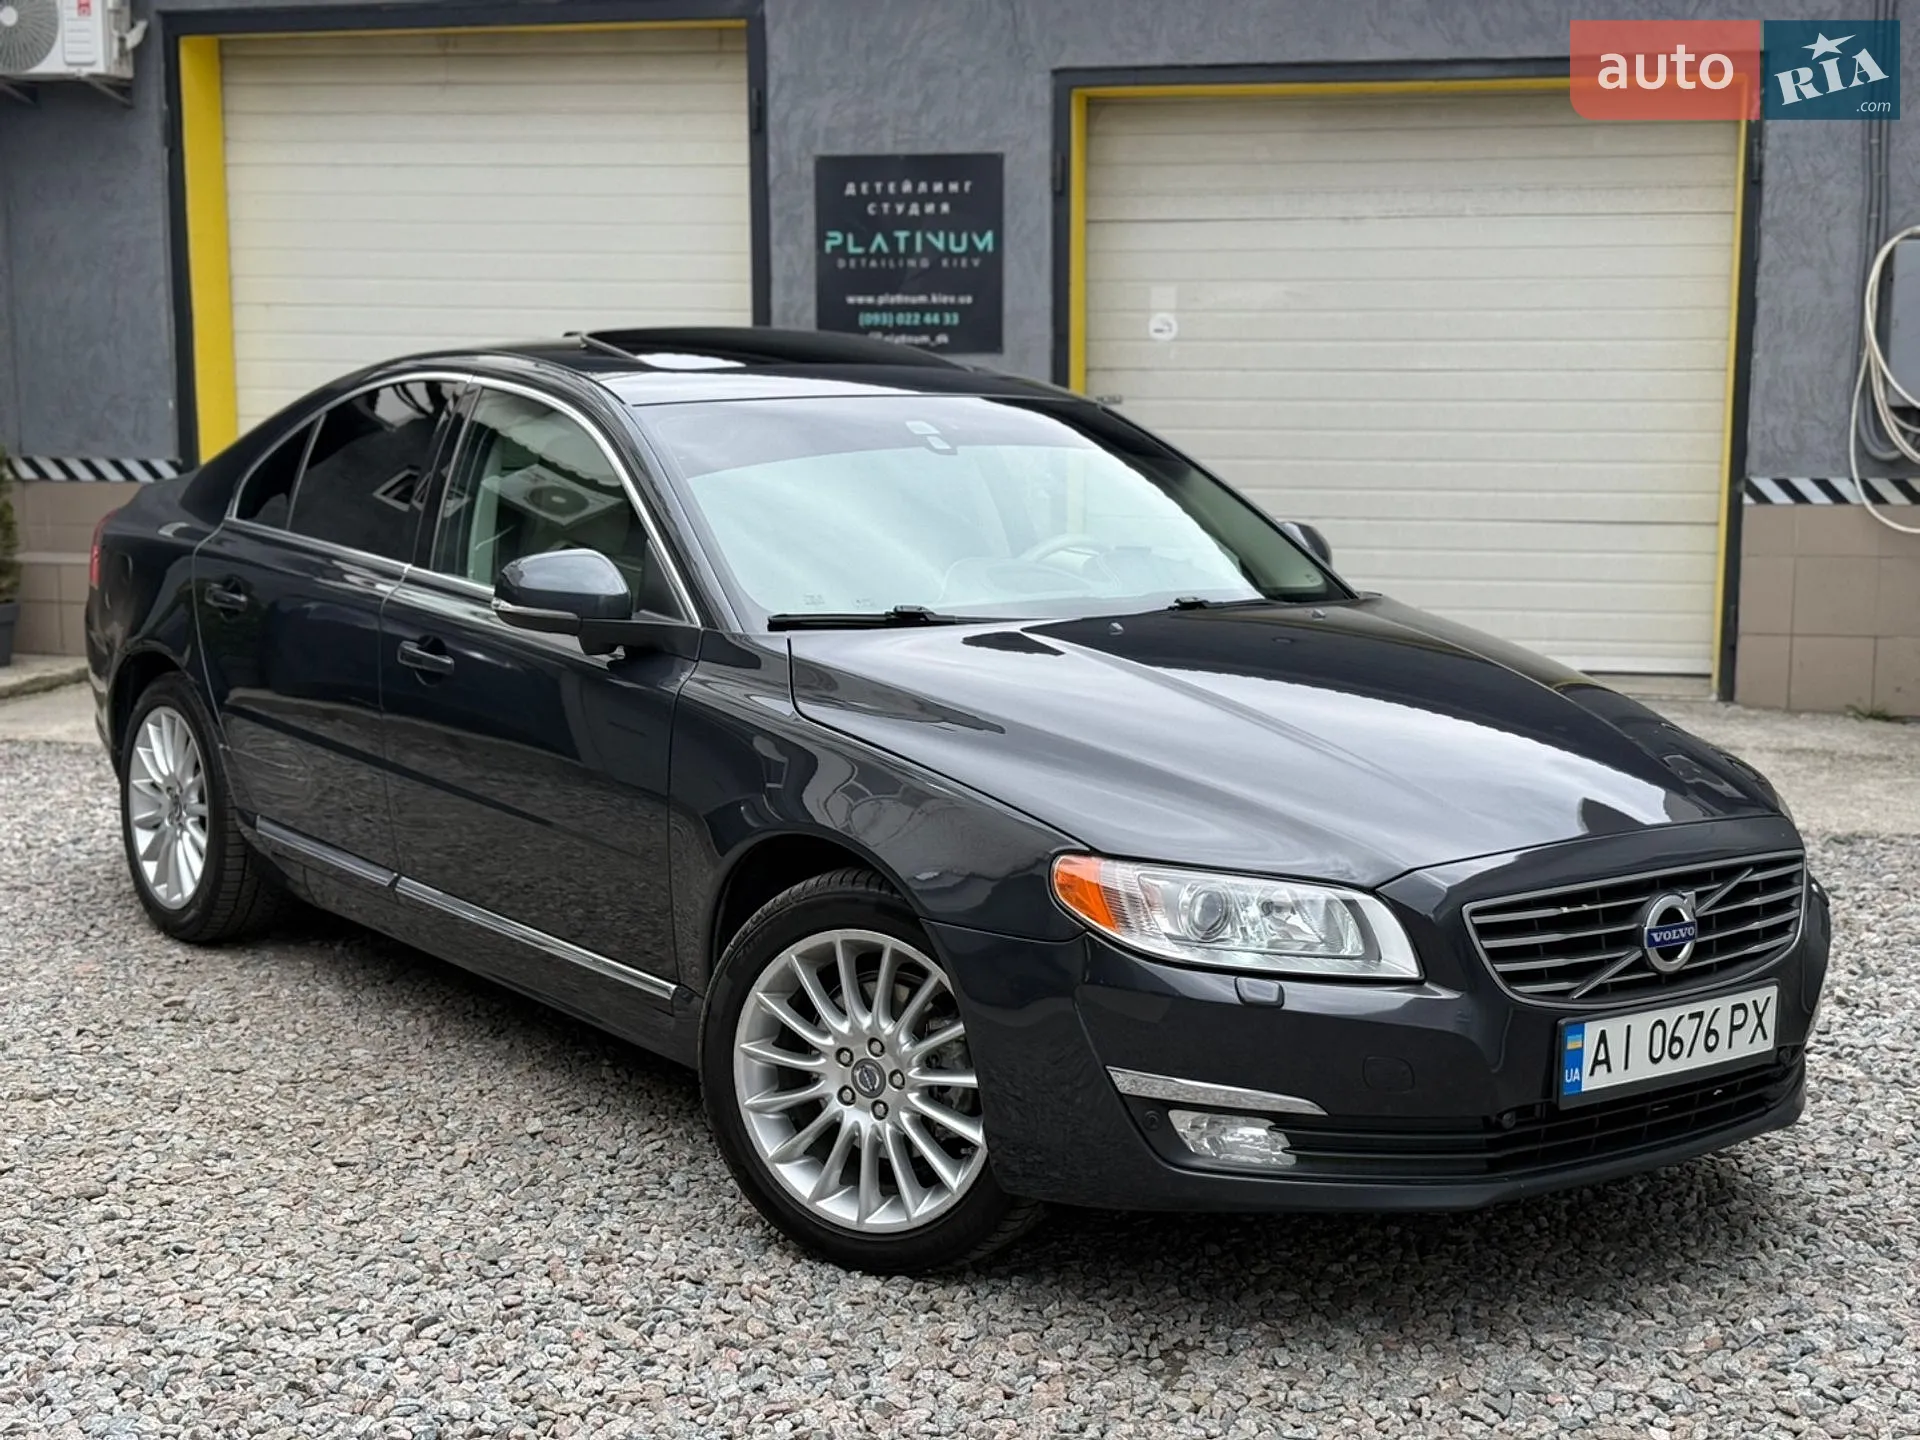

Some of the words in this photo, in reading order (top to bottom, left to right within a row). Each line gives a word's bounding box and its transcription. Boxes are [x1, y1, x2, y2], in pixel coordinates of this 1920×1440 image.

[844, 179, 973, 196] ДЕТЕЙЛИНГ
[867, 202, 950, 216] СТУДИЯ
[824, 229, 994, 254] PLATINUM
[836, 257, 930, 269] DETAILING
[941, 257, 982, 268] KIEV
[846, 292, 973, 305] www.platinum.kiev.ua
[1652, 924, 1696, 942] VOLVO
[1649, 1007, 1721, 1065] 0676
[1565, 1070, 1581, 1083] UA
